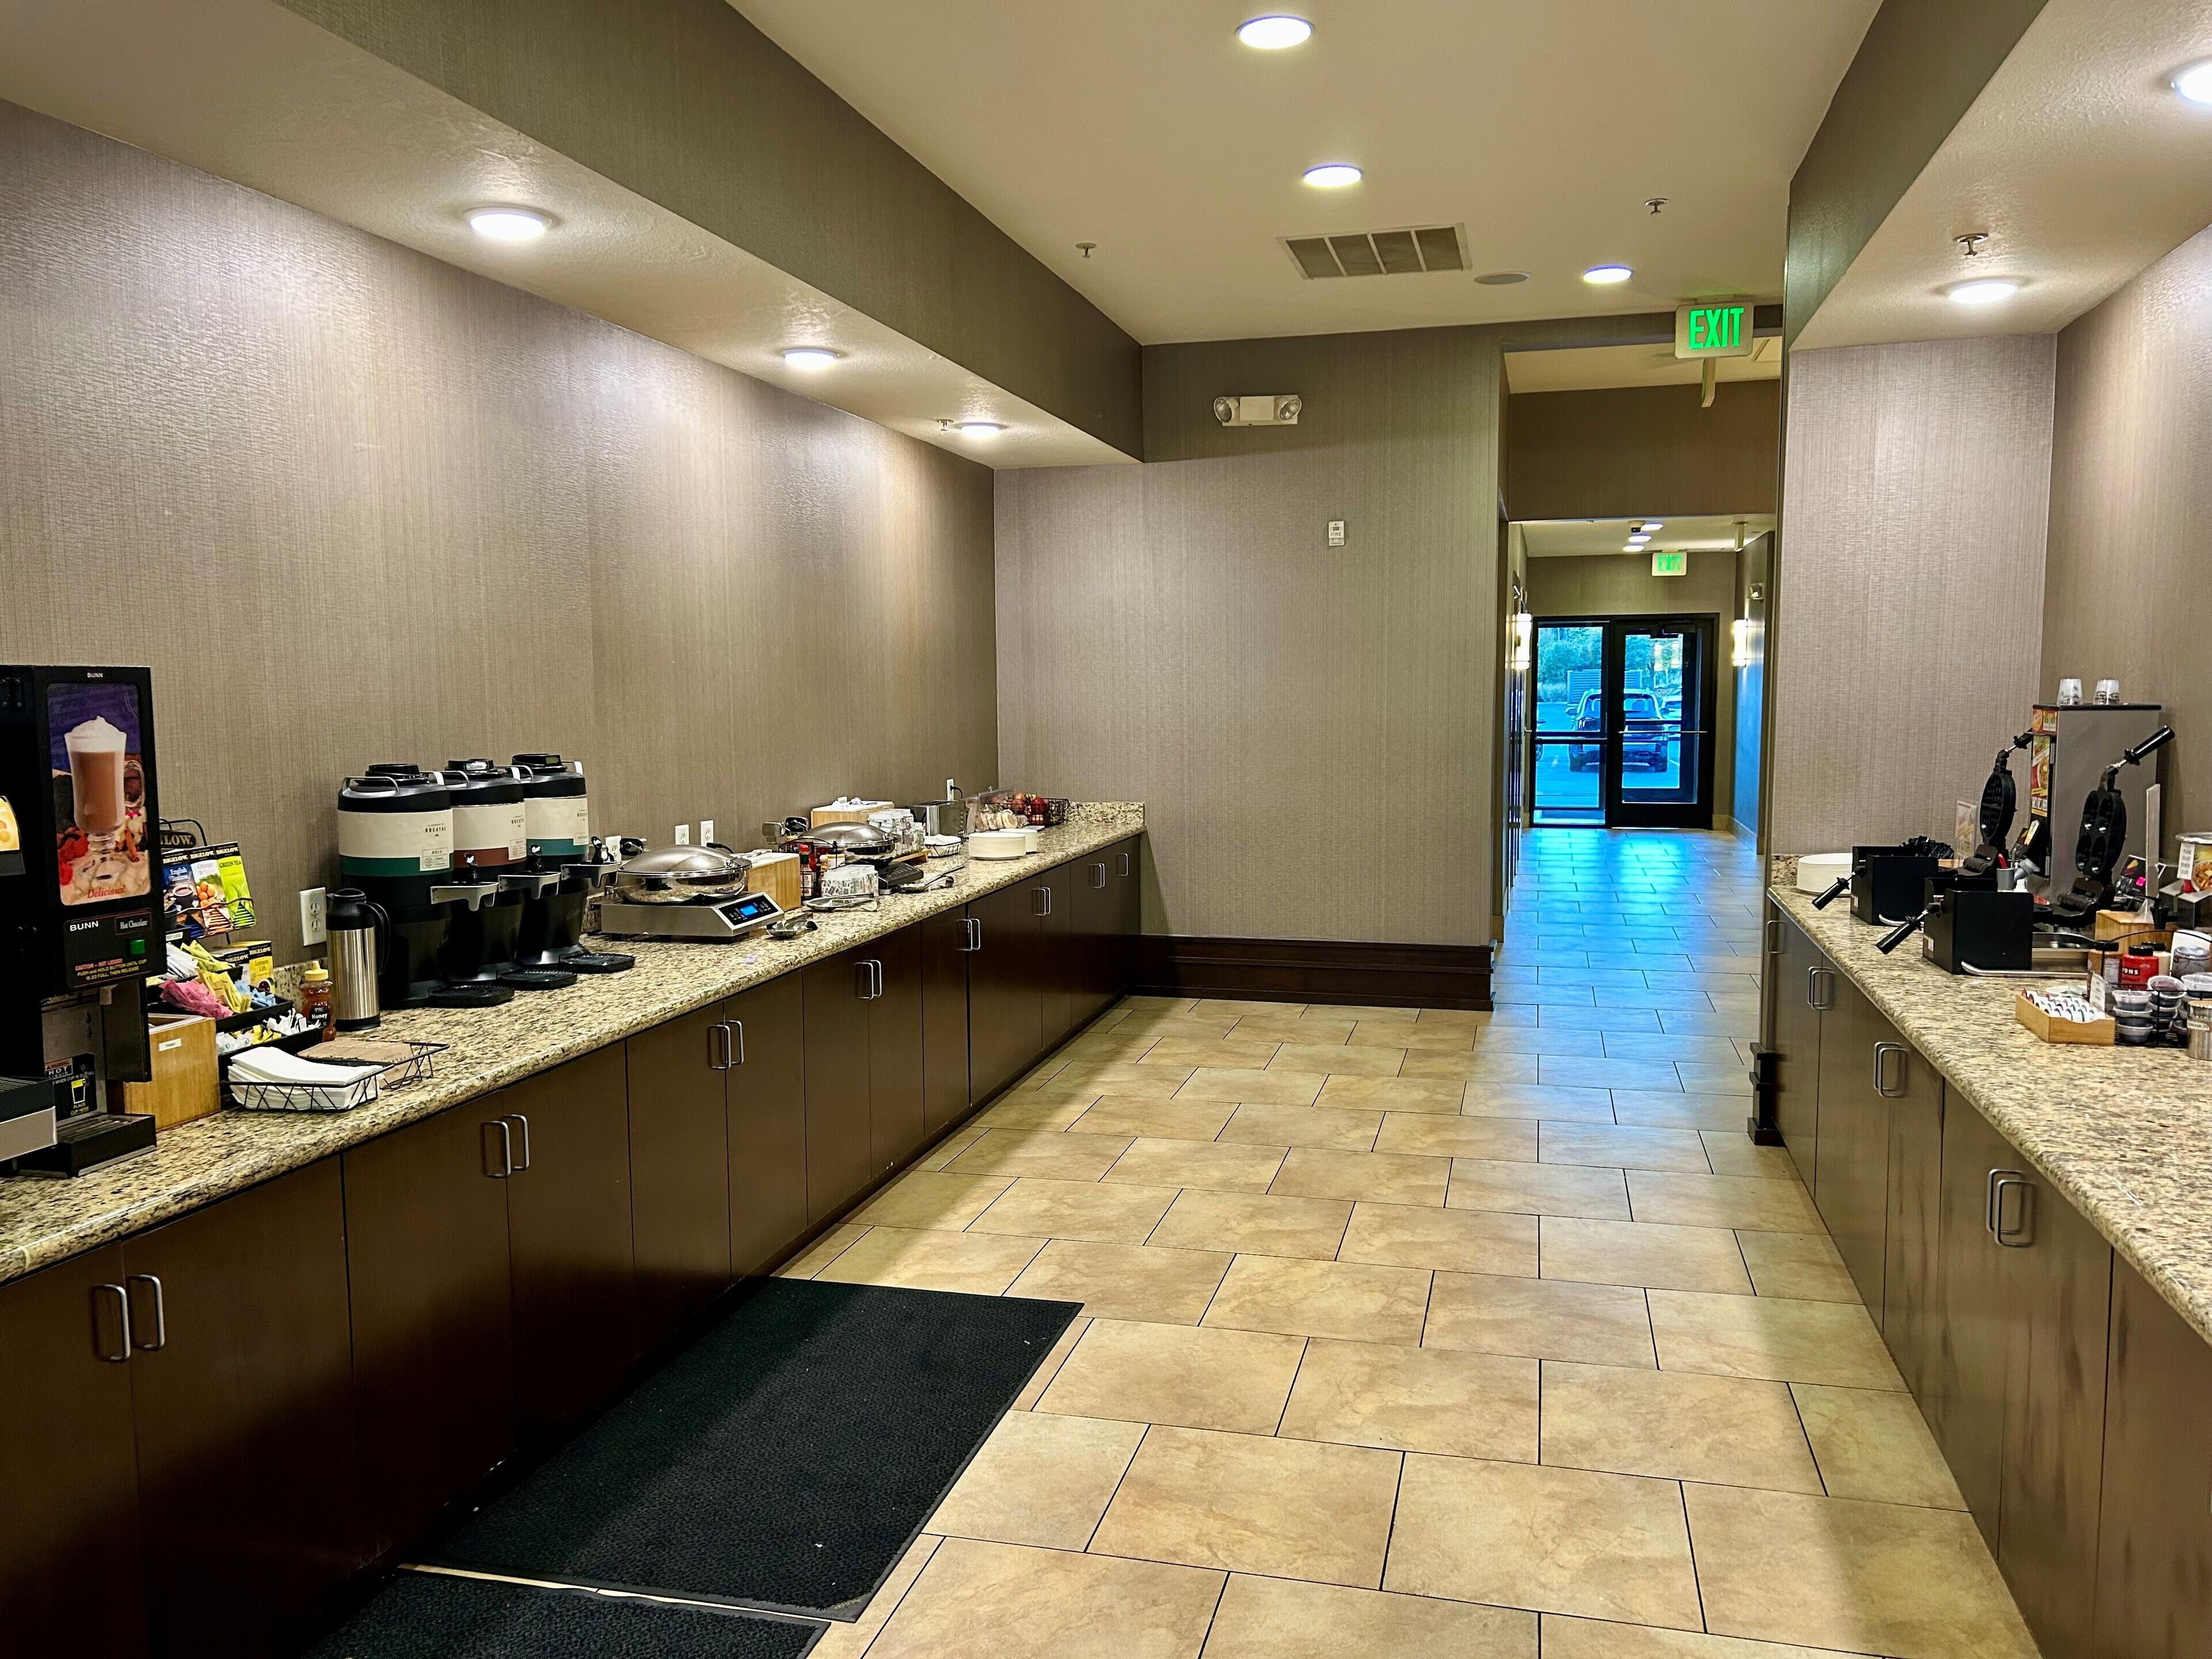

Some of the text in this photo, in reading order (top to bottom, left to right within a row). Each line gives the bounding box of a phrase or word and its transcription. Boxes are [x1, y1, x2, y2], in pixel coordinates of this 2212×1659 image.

[1689, 307, 1744, 349] EXIT
[1658, 554, 1683, 571] EXIT
[190, 850, 214, 859] BIGELOW
[216, 847, 238, 855] BIGELOW
[162, 855, 188, 863] BIGELOW
[70, 921, 99, 931] BUNN
[249, 947, 271, 955] BIGELOW
[75, 963, 94, 971] CAUTION
[48, 1066, 67, 1075] HOT
